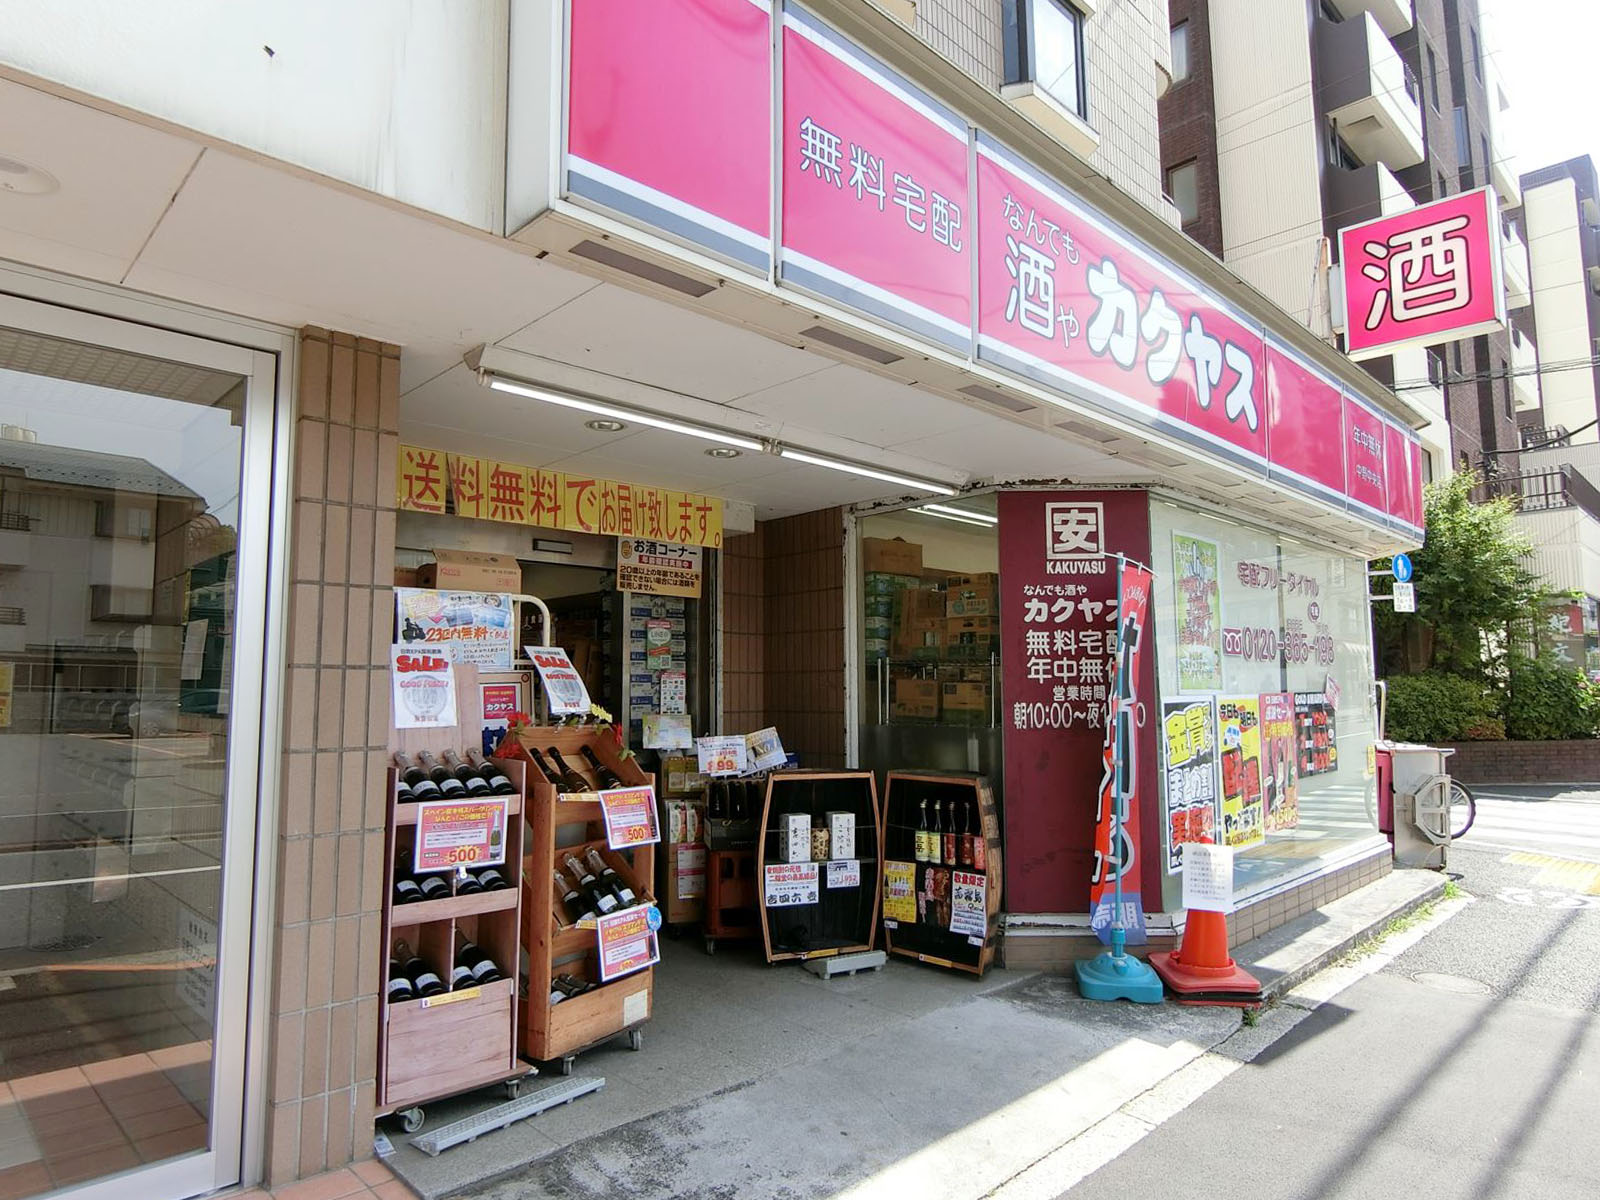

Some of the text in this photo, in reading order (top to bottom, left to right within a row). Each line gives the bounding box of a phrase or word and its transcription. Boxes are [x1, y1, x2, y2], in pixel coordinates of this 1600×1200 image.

[800, 117, 963, 253] 無料宅配
[1002, 192, 1080, 265] なんでも
[1361, 214, 1471, 331] 酒
[1005, 236, 1259, 432] 酒や カクヤス
[403, 450, 721, 547] 送料無料でお届け致します。
[1053, 508, 1098, 552] 安
[634, 540, 697, 557] お酒コーナー
[1046, 561, 1106, 574] KAKUYASU
[1238, 561, 1320, 597] 宅配フリーダイヤル
[1023, 584, 1088, 596] なんでも酒や
[1243, 627, 1335, 665] 0120-365-198
[1052, 685, 1106, 701] 営業時間
[486, 703, 514, 711] カクヤス
[628, 828, 645, 841] 500
[448, 848, 477, 863] 500
[954, 873, 985, 888] 数量限定
